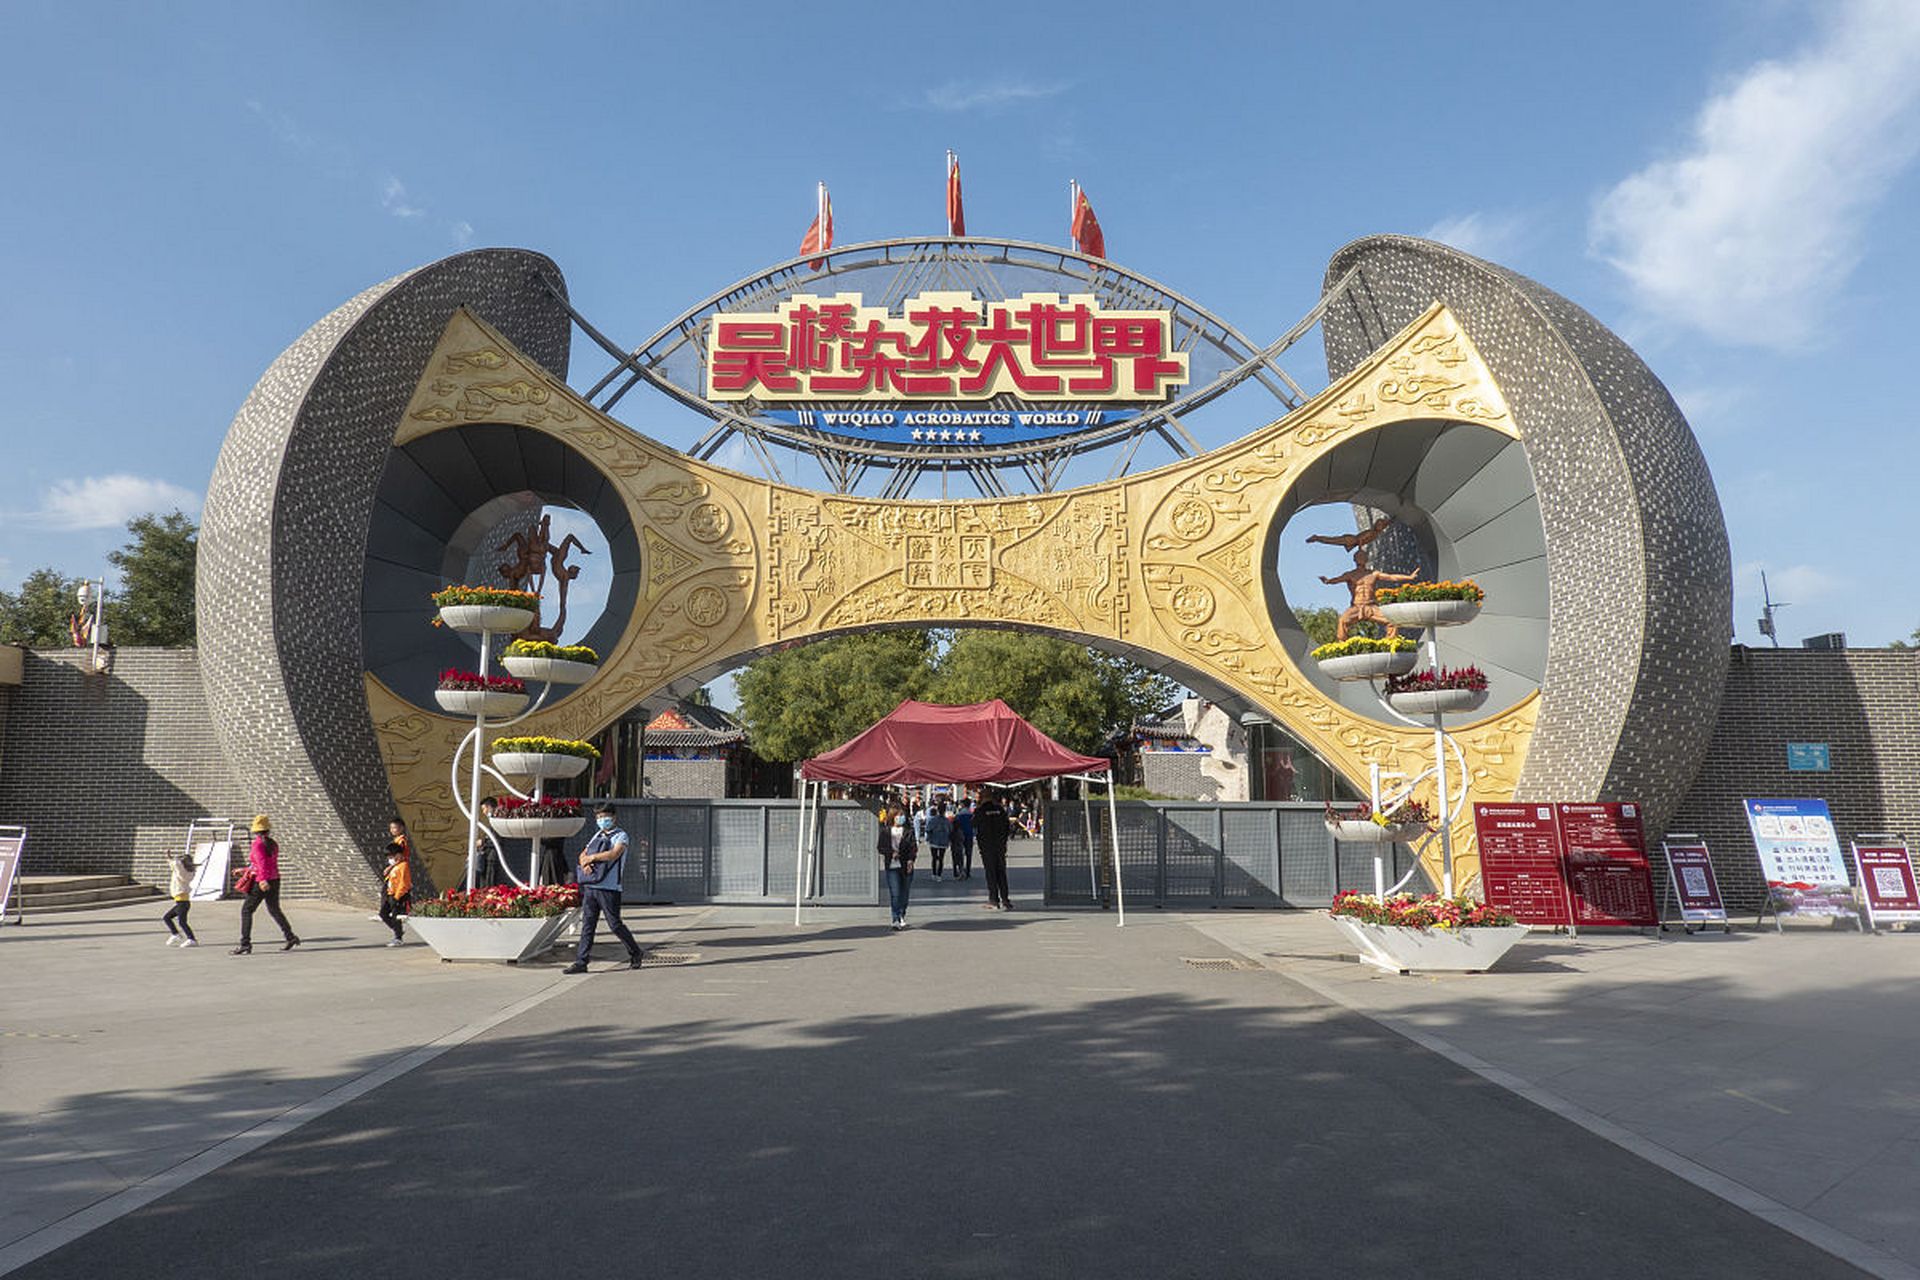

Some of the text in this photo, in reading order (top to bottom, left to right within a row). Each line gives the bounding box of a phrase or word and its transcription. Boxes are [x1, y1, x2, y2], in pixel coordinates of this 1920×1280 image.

[713, 303, 1180, 393] 吴桥杂技大世界
[823, 412, 1079, 427] WUQIAO ACROBATICS WORLD
